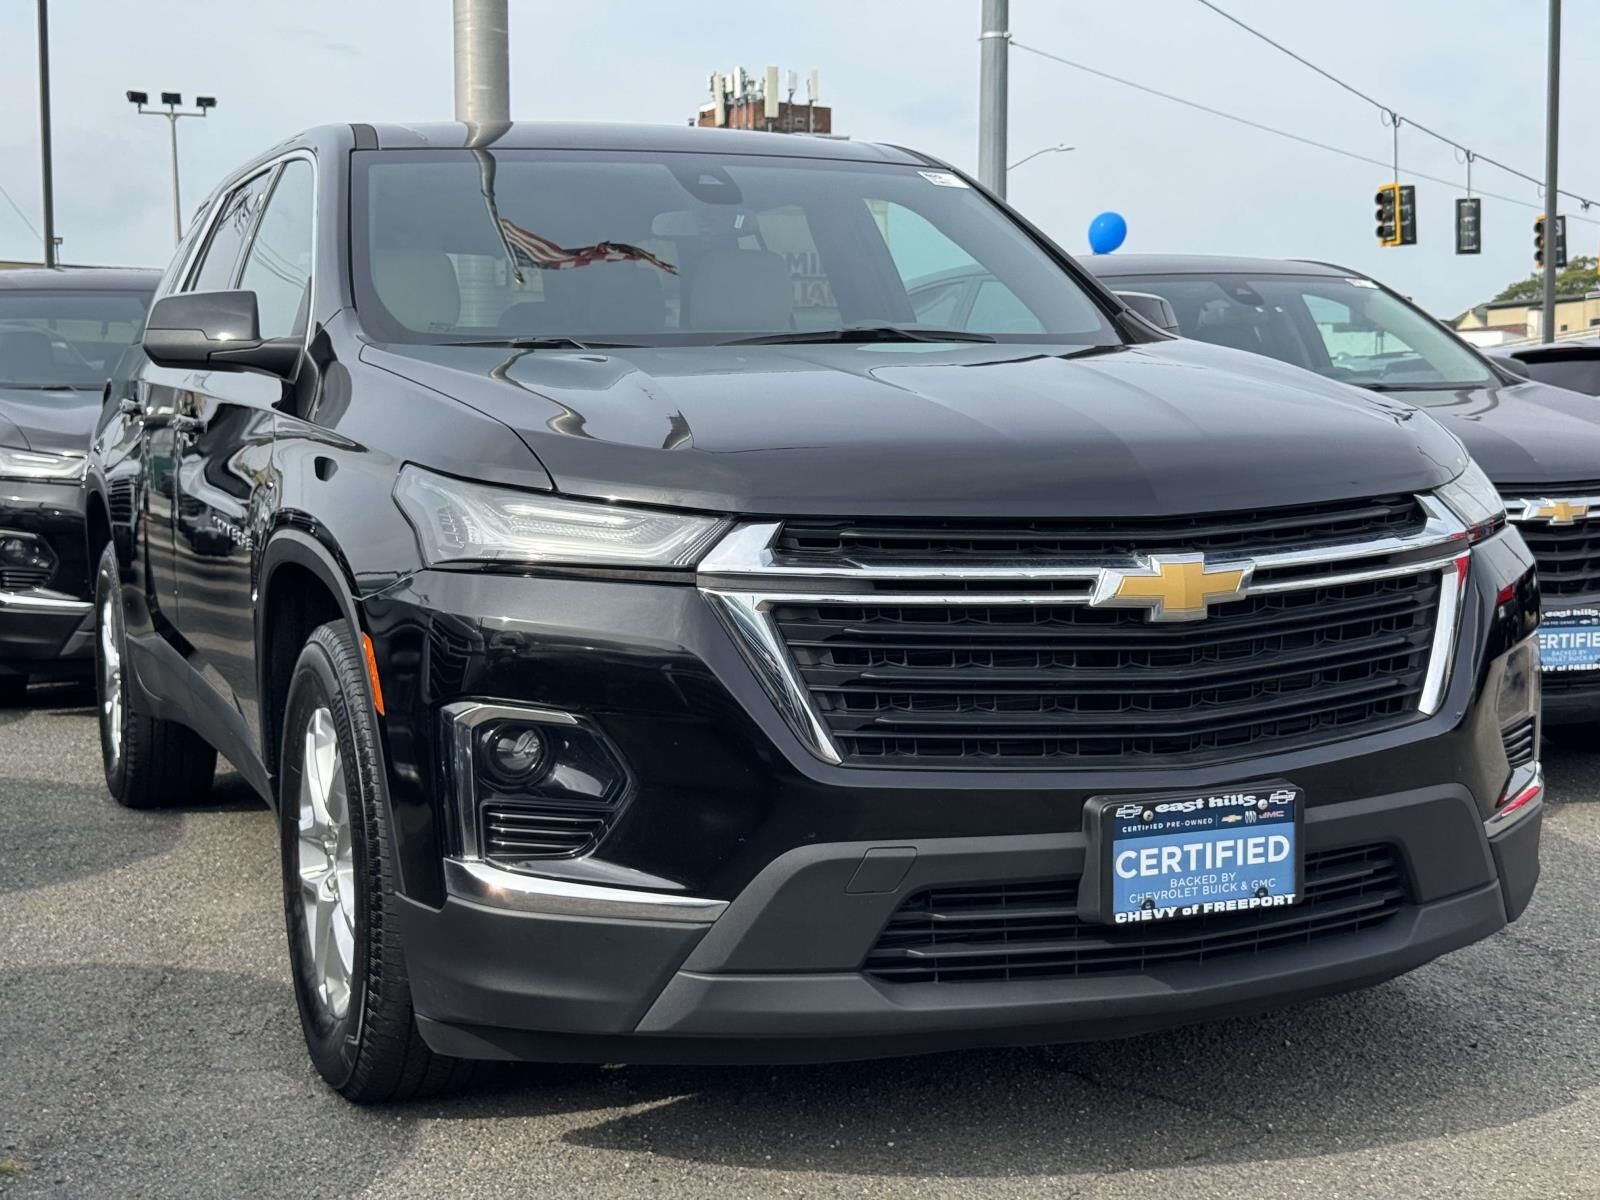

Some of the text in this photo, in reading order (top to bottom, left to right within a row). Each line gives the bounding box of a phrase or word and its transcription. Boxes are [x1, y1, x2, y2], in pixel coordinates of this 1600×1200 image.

[1155, 798, 1204, 813] east
[1208, 793, 1257, 810] hills
[1122, 822, 1164, 833] CERTIFIED
[1166, 817, 1213, 828] PRE-OWNED
[1115, 835, 1290, 879] CERTIFIED
[1129, 878, 1276, 904] CHEVROLET BUICK & GMC
[1170, 872, 1236, 888] BACKED BY
[1115, 893, 1297, 924] CHEVY of FREEPORT
